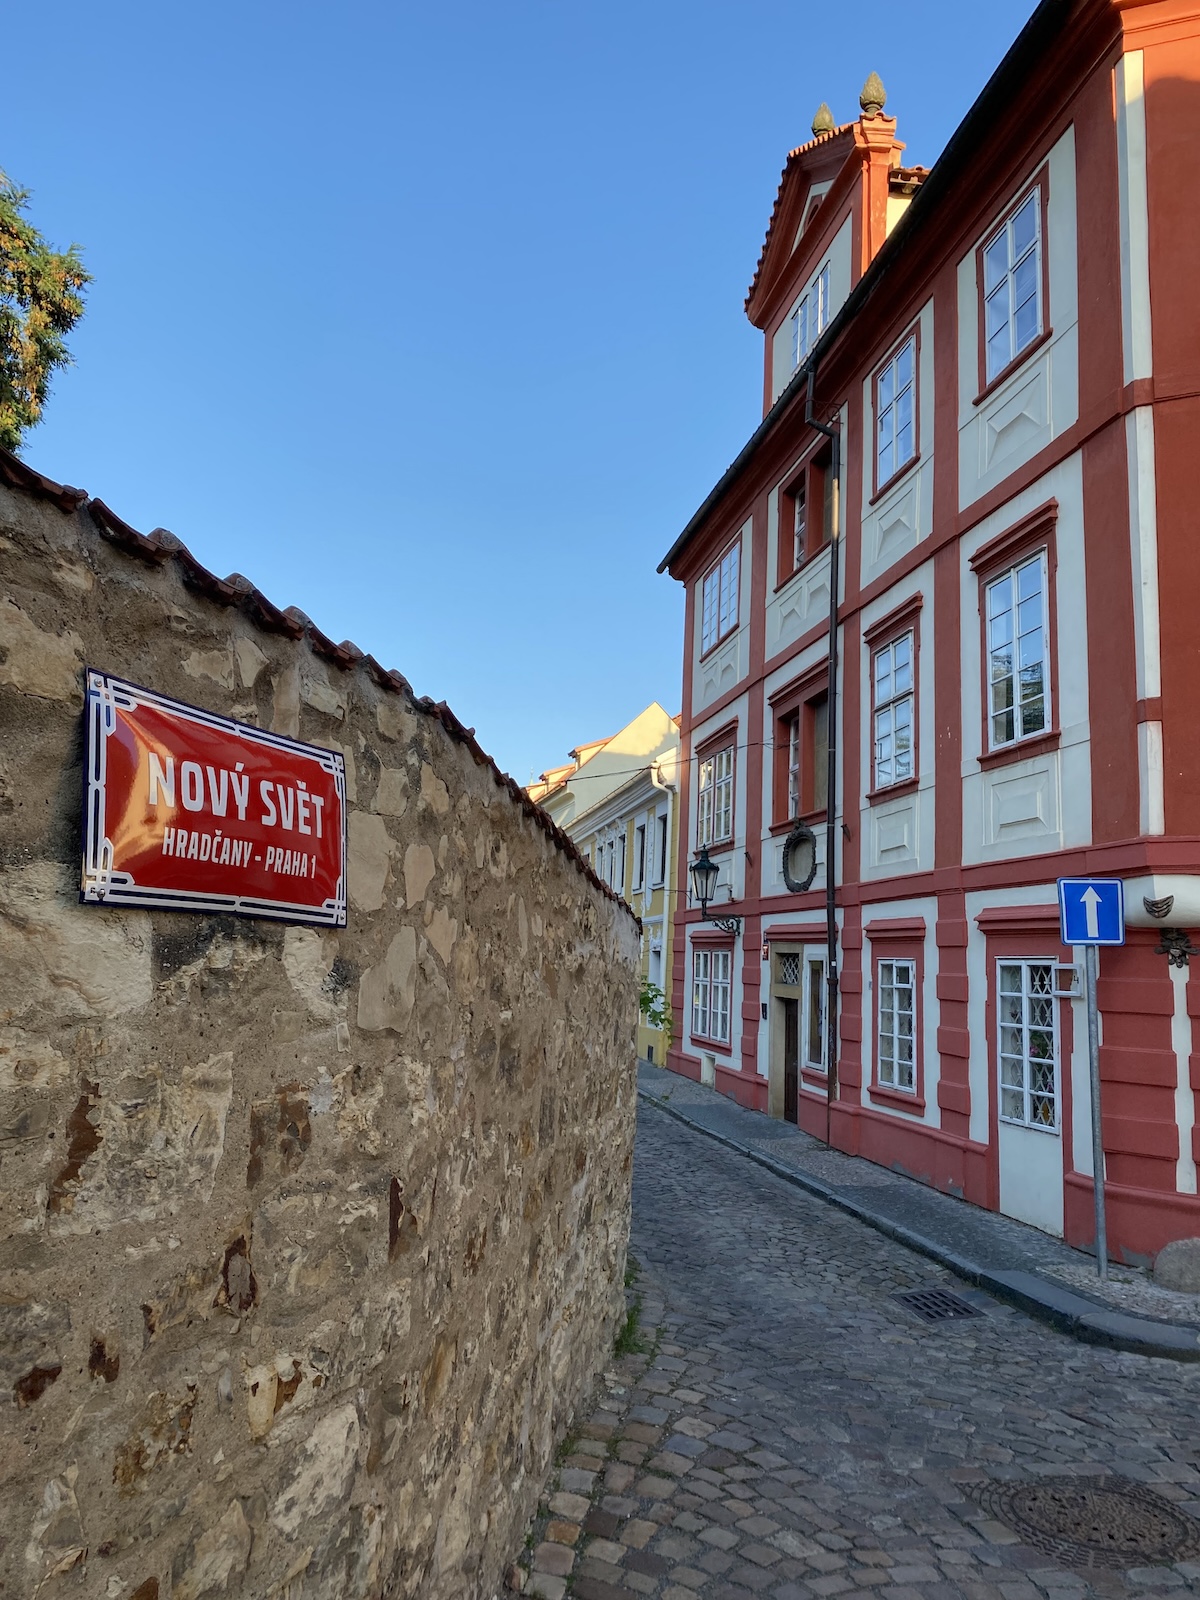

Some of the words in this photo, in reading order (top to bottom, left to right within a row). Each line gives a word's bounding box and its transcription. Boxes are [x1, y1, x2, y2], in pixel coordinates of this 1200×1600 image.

[148, 752, 249, 821] NOVÝ
[259, 780, 324, 839] SVĚT
[162, 827, 253, 868] HRADČANY
[264, 846, 308, 879] PRAHA
[310, 855, 316, 879] 1
